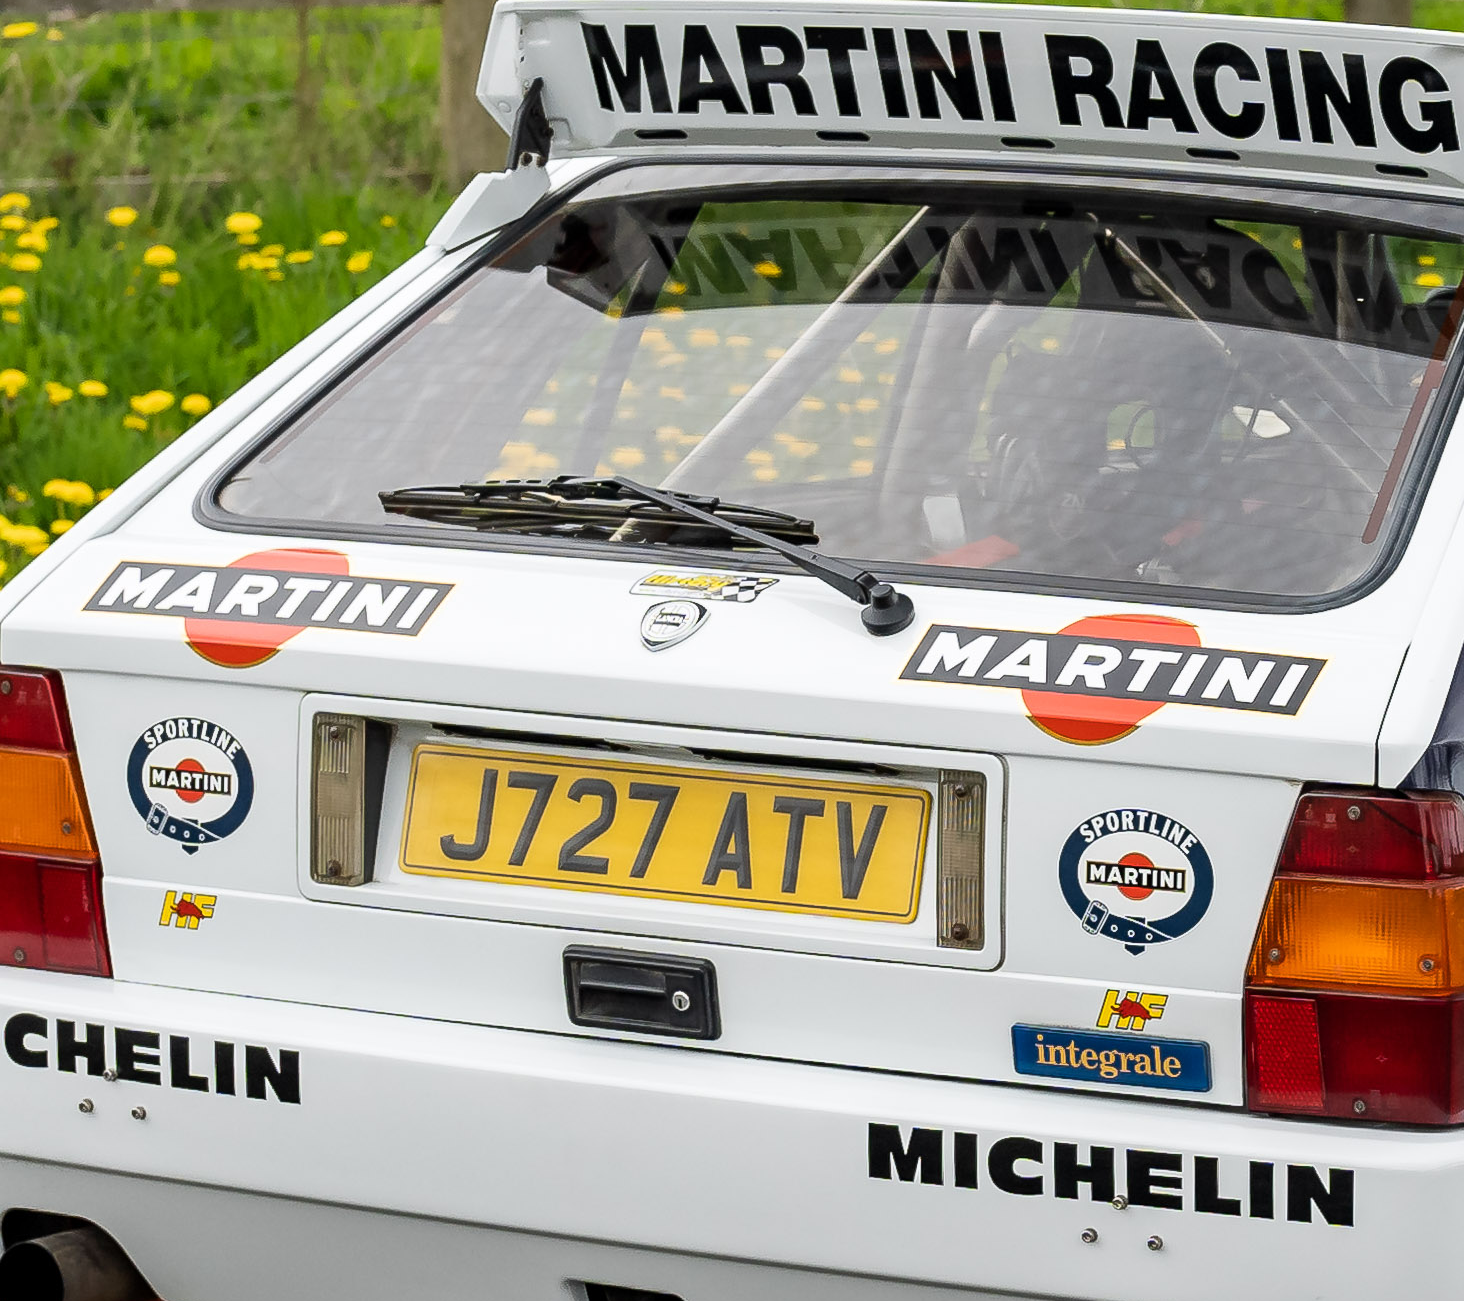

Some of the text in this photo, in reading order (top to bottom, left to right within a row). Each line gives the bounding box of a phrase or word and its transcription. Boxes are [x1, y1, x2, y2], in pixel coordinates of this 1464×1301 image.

[581, 23, 1459, 154] MARTINI RACING
[96, 566, 440, 630] MARTINI
[916, 632, 1309, 707] MARTINI
[143, 721, 242, 761] SPORTLINE
[151, 768, 231, 794] MARTINI
[440, 768, 887, 900] J727 ATV
[1079, 809, 1199, 855] SPORTLINE
[1089, 864, 1186, 893] MARTINI
[159, 890, 218, 930] HF
[1096, 989, 1169, 1031] HF
[1035, 1033, 1182, 1079] integrale
[867, 1122, 1356, 1228] MICHELIN
